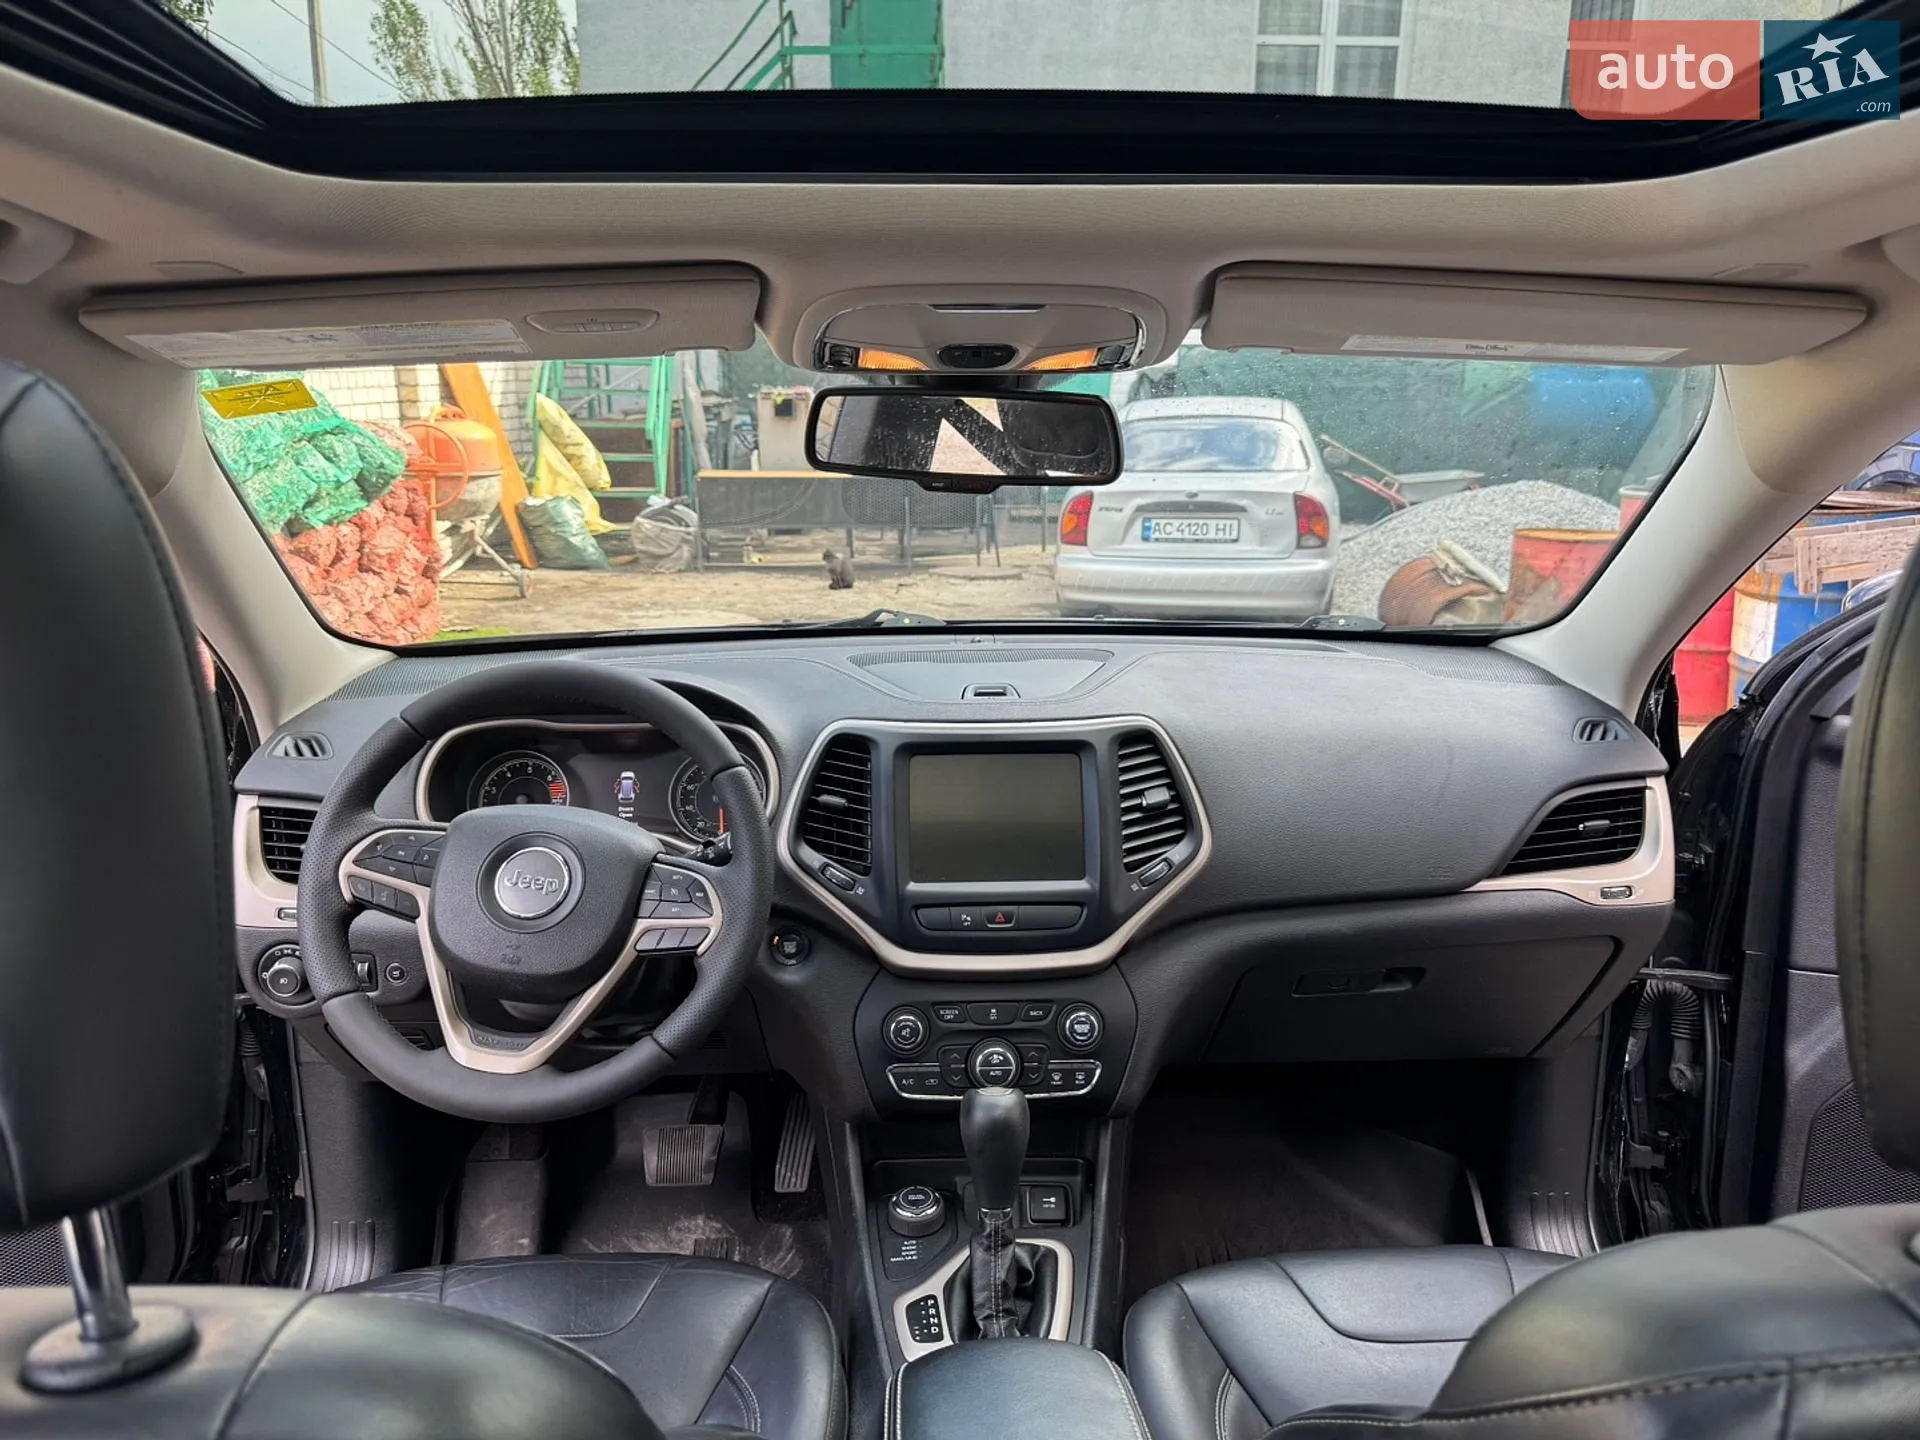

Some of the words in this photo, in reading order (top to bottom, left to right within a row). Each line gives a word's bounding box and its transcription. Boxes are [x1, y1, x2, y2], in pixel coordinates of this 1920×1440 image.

[1152, 522, 1173, 536] AC
[1176, 522, 1209, 536] 4120
[1215, 523, 1233, 536] HI
[504, 869, 559, 895] Jeep
[930, 1326, 939, 1334] D
